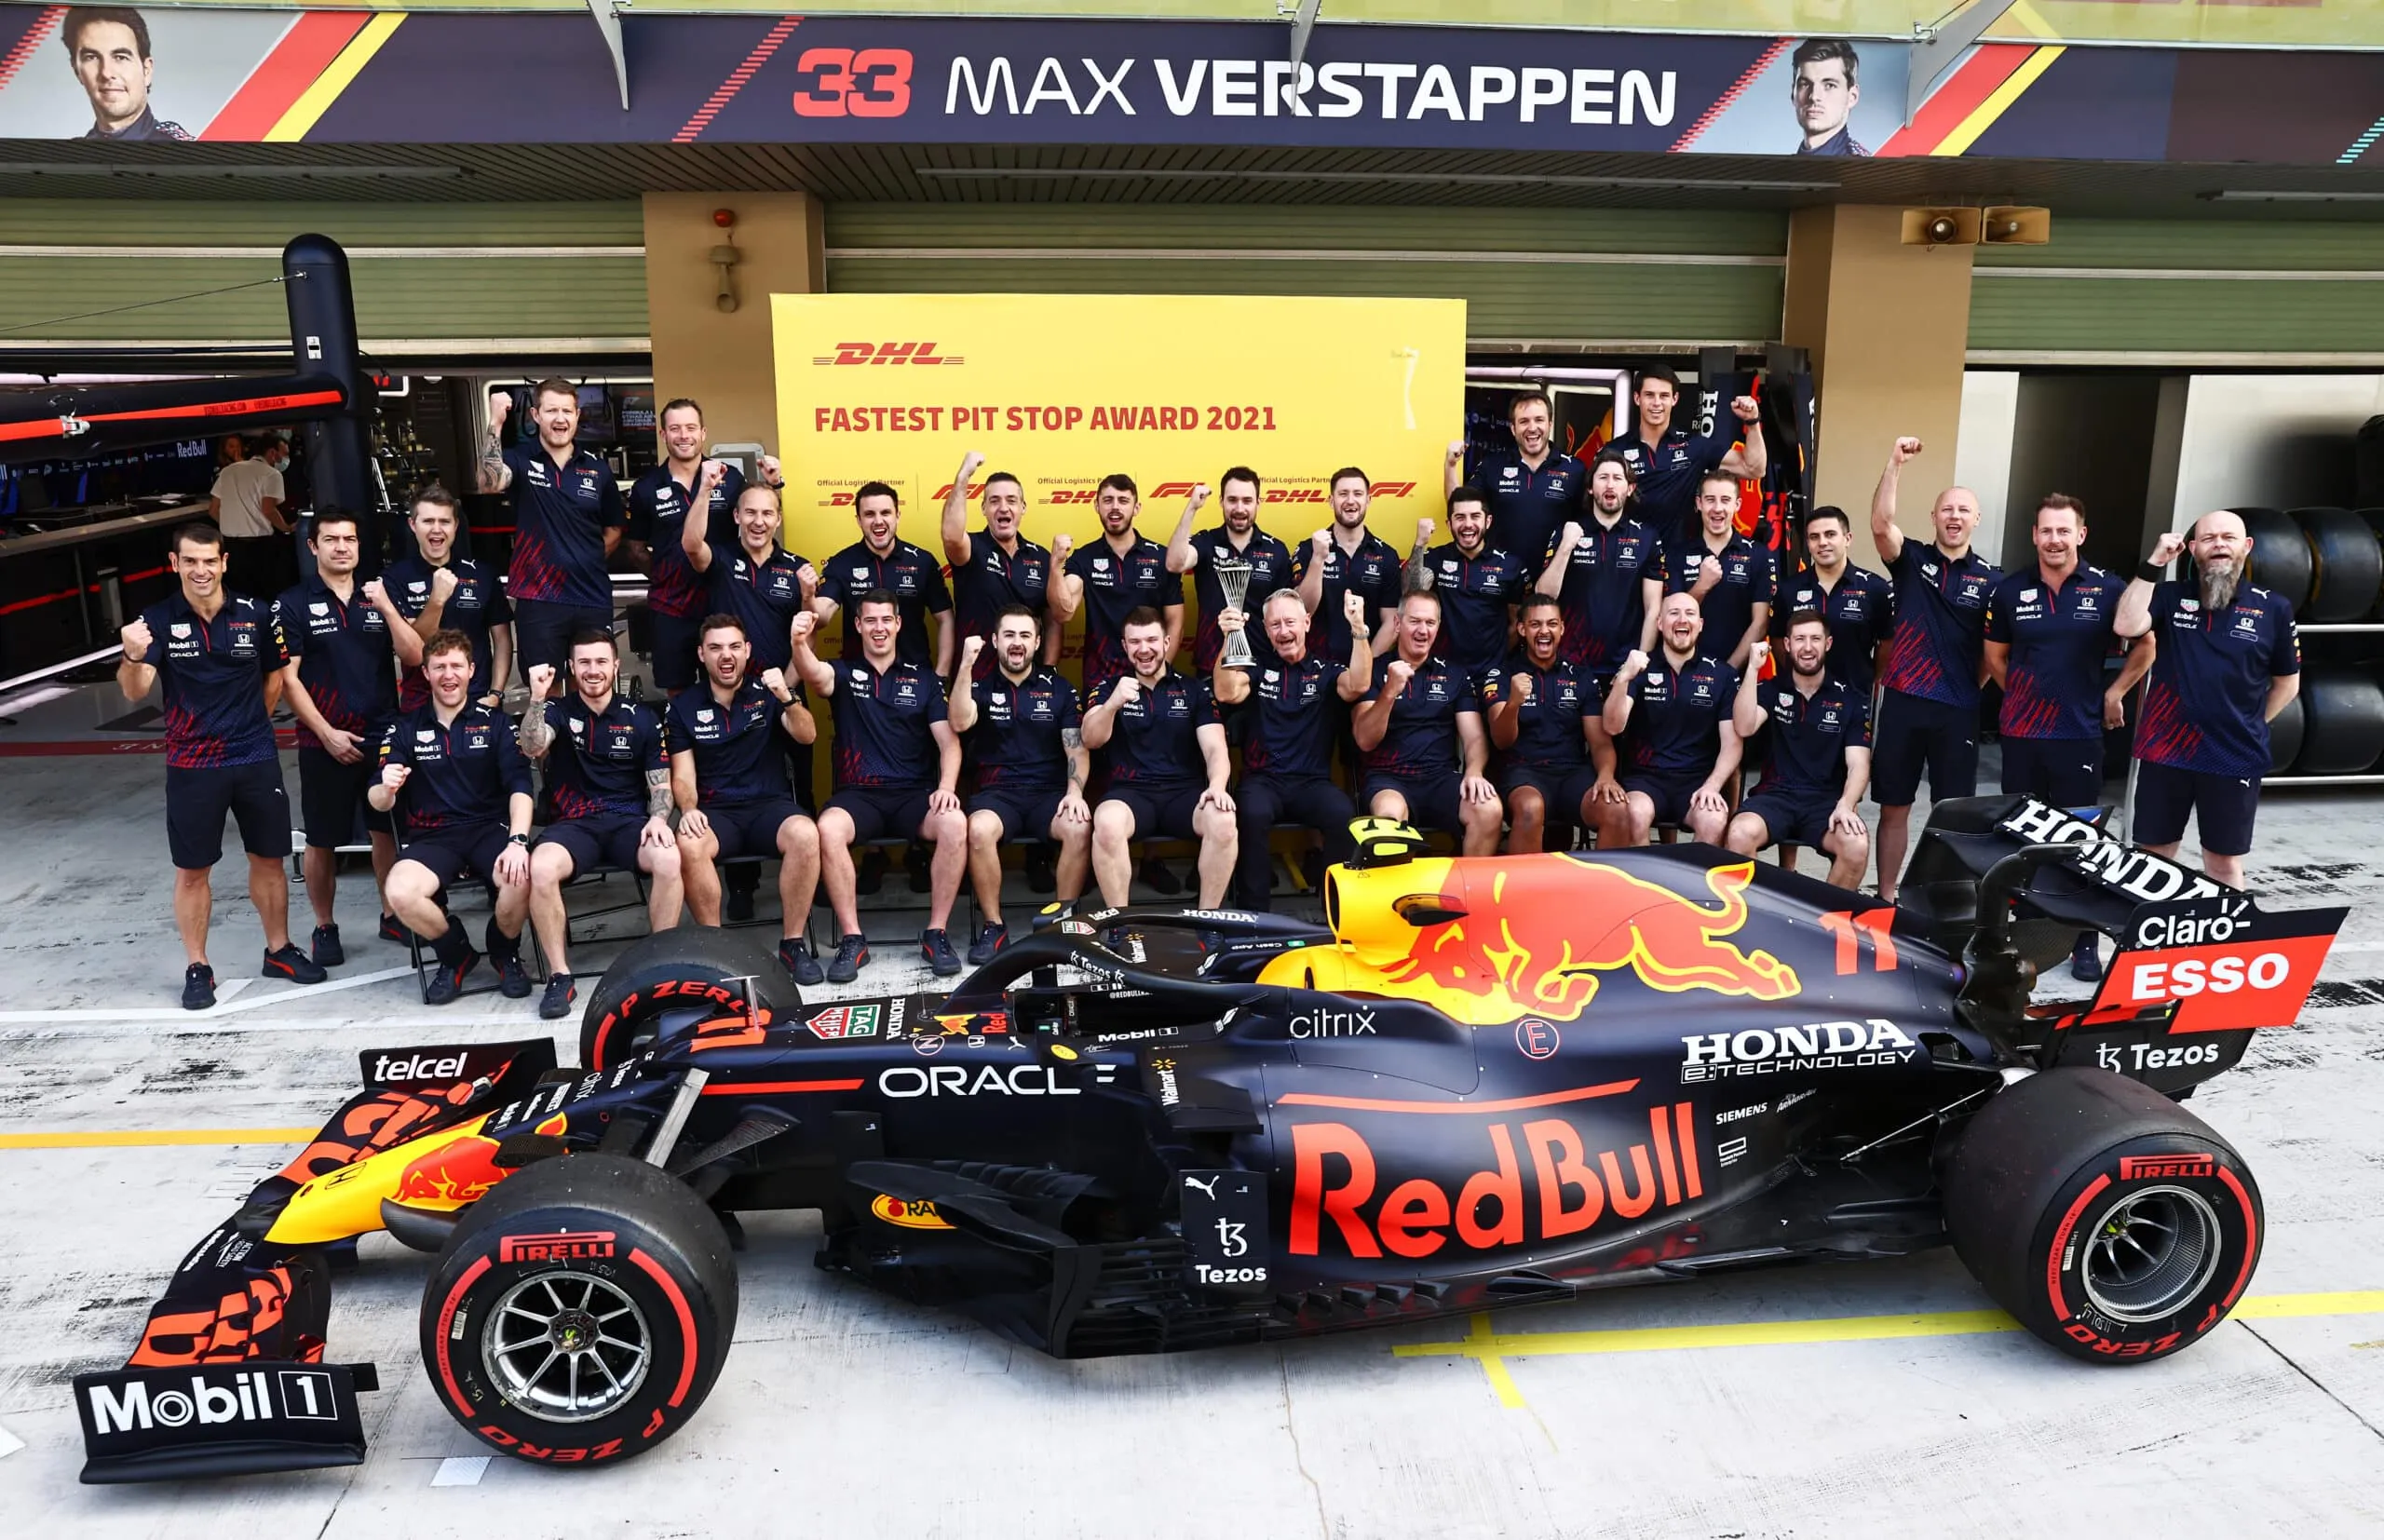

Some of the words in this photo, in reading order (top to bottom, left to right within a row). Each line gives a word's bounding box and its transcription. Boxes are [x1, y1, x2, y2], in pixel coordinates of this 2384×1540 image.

[793, 47, 913, 117] 33
[945, 56, 1136, 116] MAX
[1153, 59, 1677, 127] VERSTAPPEN
[833, 342, 946, 365] DHL
[815, 408, 941, 432] FASTEST
[951, 408, 999, 431] PIT
[1006, 407, 1082, 432] STOP
[1090, 407, 1199, 431] AWARD
[1207, 407, 1277, 431] 2021
[1280, 477, 1309, 485] Logistics
[1050, 491, 1097, 504] DH
[1266, 490, 1326, 503] DHL
[312, 627, 338, 635] ORACLE
[2003, 798, 2223, 901] HONDA
[1183, 909, 1258, 924] HONDA
[1818, 907, 1897, 976] 11
[1080, 956, 1111, 979] Tezos
[2132, 952, 2290, 1000] ESSO
[620, 992, 639, 1019] P
[887, 997, 906, 1041] HONDA
[816, 1007, 844, 1037] HEUER
[850, 1006, 874, 1035] TAG
[981, 1012, 1007, 1033] Red
[1289, 1005, 1376, 1039] citrix
[1098, 1029, 1156, 1043] Mobil
[1681, 1019, 1916, 1065] HONDA
[373, 1052, 468, 1082] telcel
[2131, 1042, 2219, 1069] Tezos
[878, 1064, 1117, 1097] ORACLE
[1158, 1068, 1180, 1106] Walmart
[1715, 1102, 1768, 1125] SIEMENS
[2120, 1153, 2214, 1181] PIRELLI
[500, 1231, 616, 1263] PIRELLI
[1196, 1263, 1267, 1284] Tezos
[2197, 1304, 2218, 1332] P
[2064, 1324, 2183, 1357] ZERO
[88, 1371, 274, 1435] Mobil
[643, 1409, 666, 1439] P
[478, 1425, 624, 1463] ZERO
